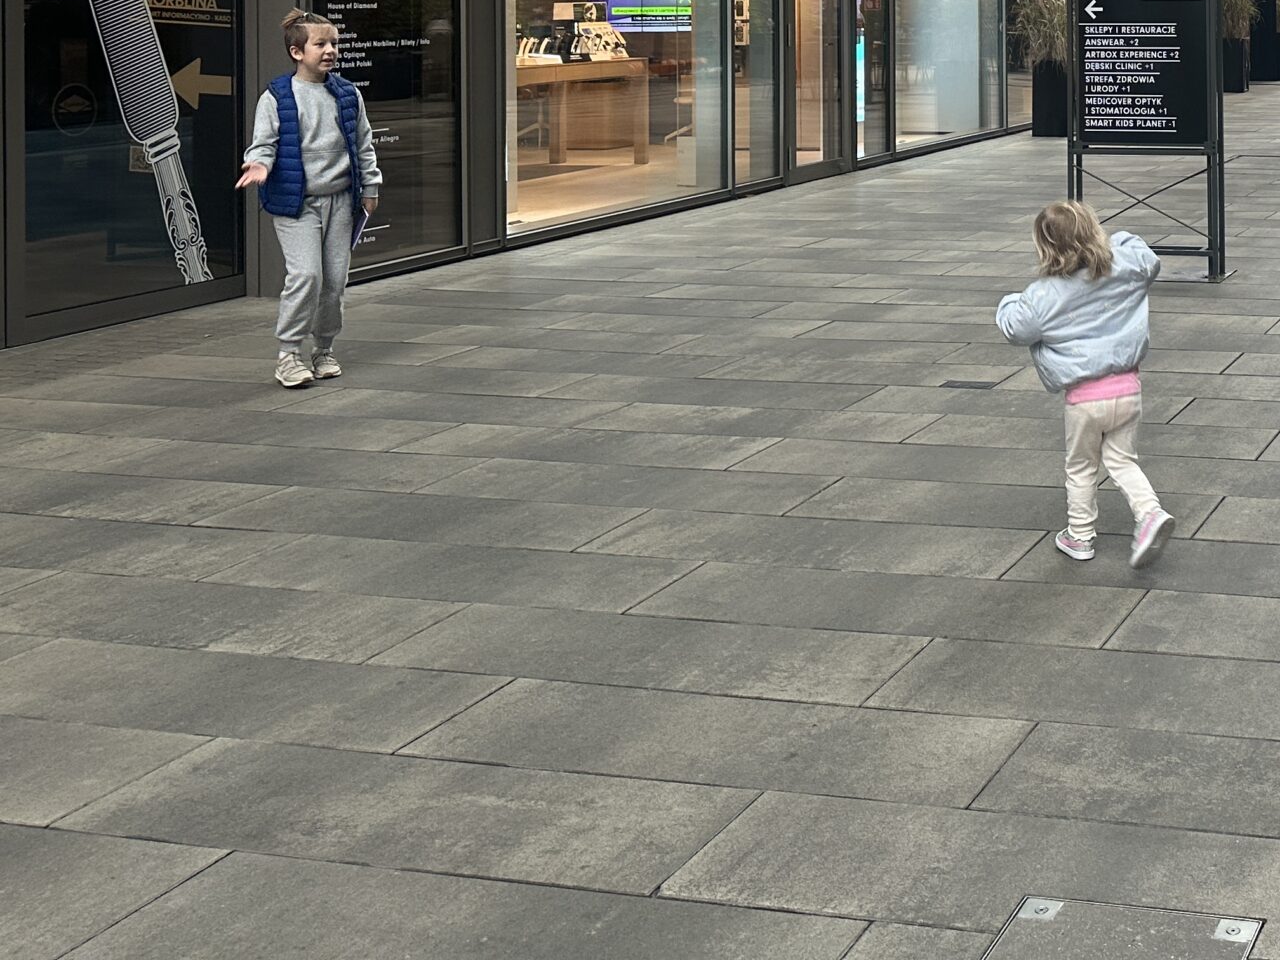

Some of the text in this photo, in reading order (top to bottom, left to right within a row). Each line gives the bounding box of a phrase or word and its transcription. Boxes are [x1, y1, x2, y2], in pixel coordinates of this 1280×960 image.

[1085, 26, 1176, 34] SKLEPY I RESTAURACJE
[352, 40, 372, 49] Fabryki
[1130, 38, 1139, 46] +2
[343, 52, 365, 60] Optique
[1085, 51, 1179, 59] ARTBOX EXPERIENCE +2
[1085, 62, 1154, 71] DĘBSKI CLINIC +1
[1085, 75, 1155, 84] STREFA ZDROWIA
[1085, 85, 1131, 93] I URODY +1
[1085, 97, 1132, 105] MEDICOVER
[1091, 107, 1156, 115] STOMATOLOGIA
[1158, 107, 1168, 115] +1
[1085, 119, 1113, 127] SMART
[1115, 119, 1134, 127] KIDS
[1169, 120, 1176, 128] -1
[380, 135, 399, 143] Allegro
